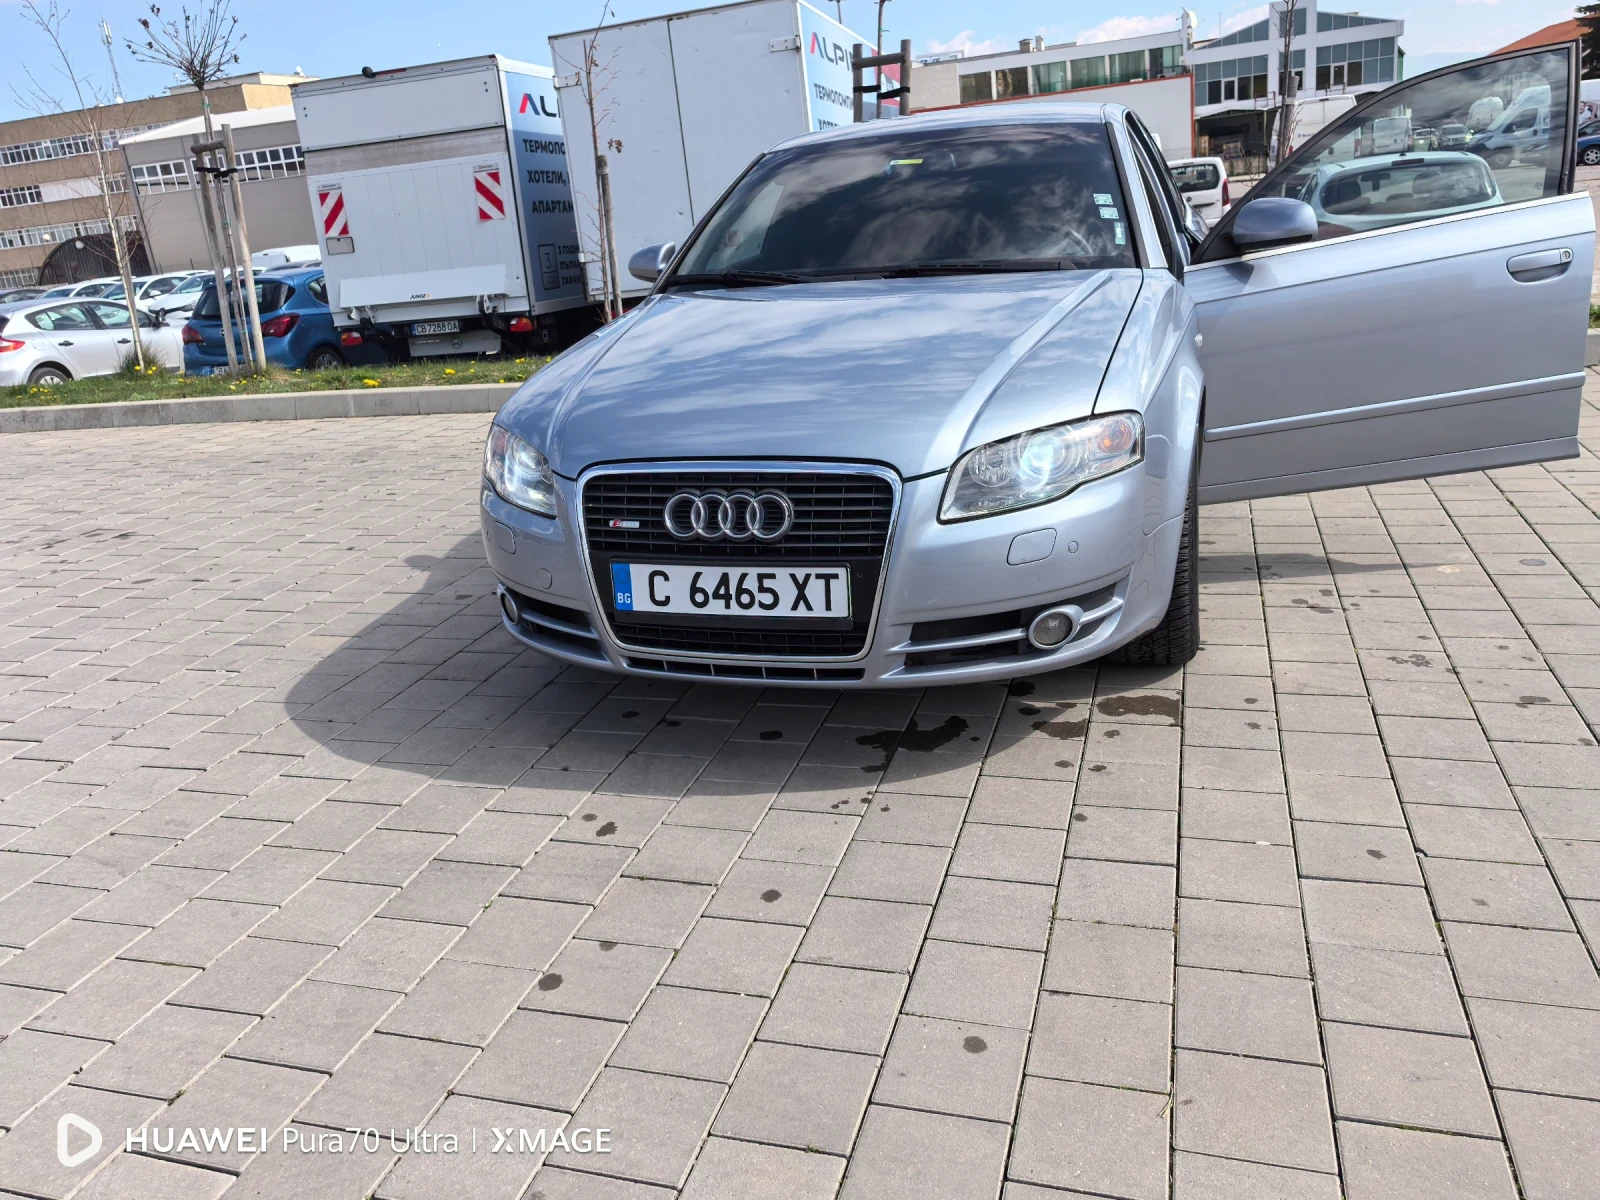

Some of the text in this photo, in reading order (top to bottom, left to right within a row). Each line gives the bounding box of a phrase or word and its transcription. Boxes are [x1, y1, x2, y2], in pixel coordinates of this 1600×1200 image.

[519, 93, 560, 118] AL
[617, 593, 631, 604] BG
[648, 570, 839, 612] C 6465 XT
